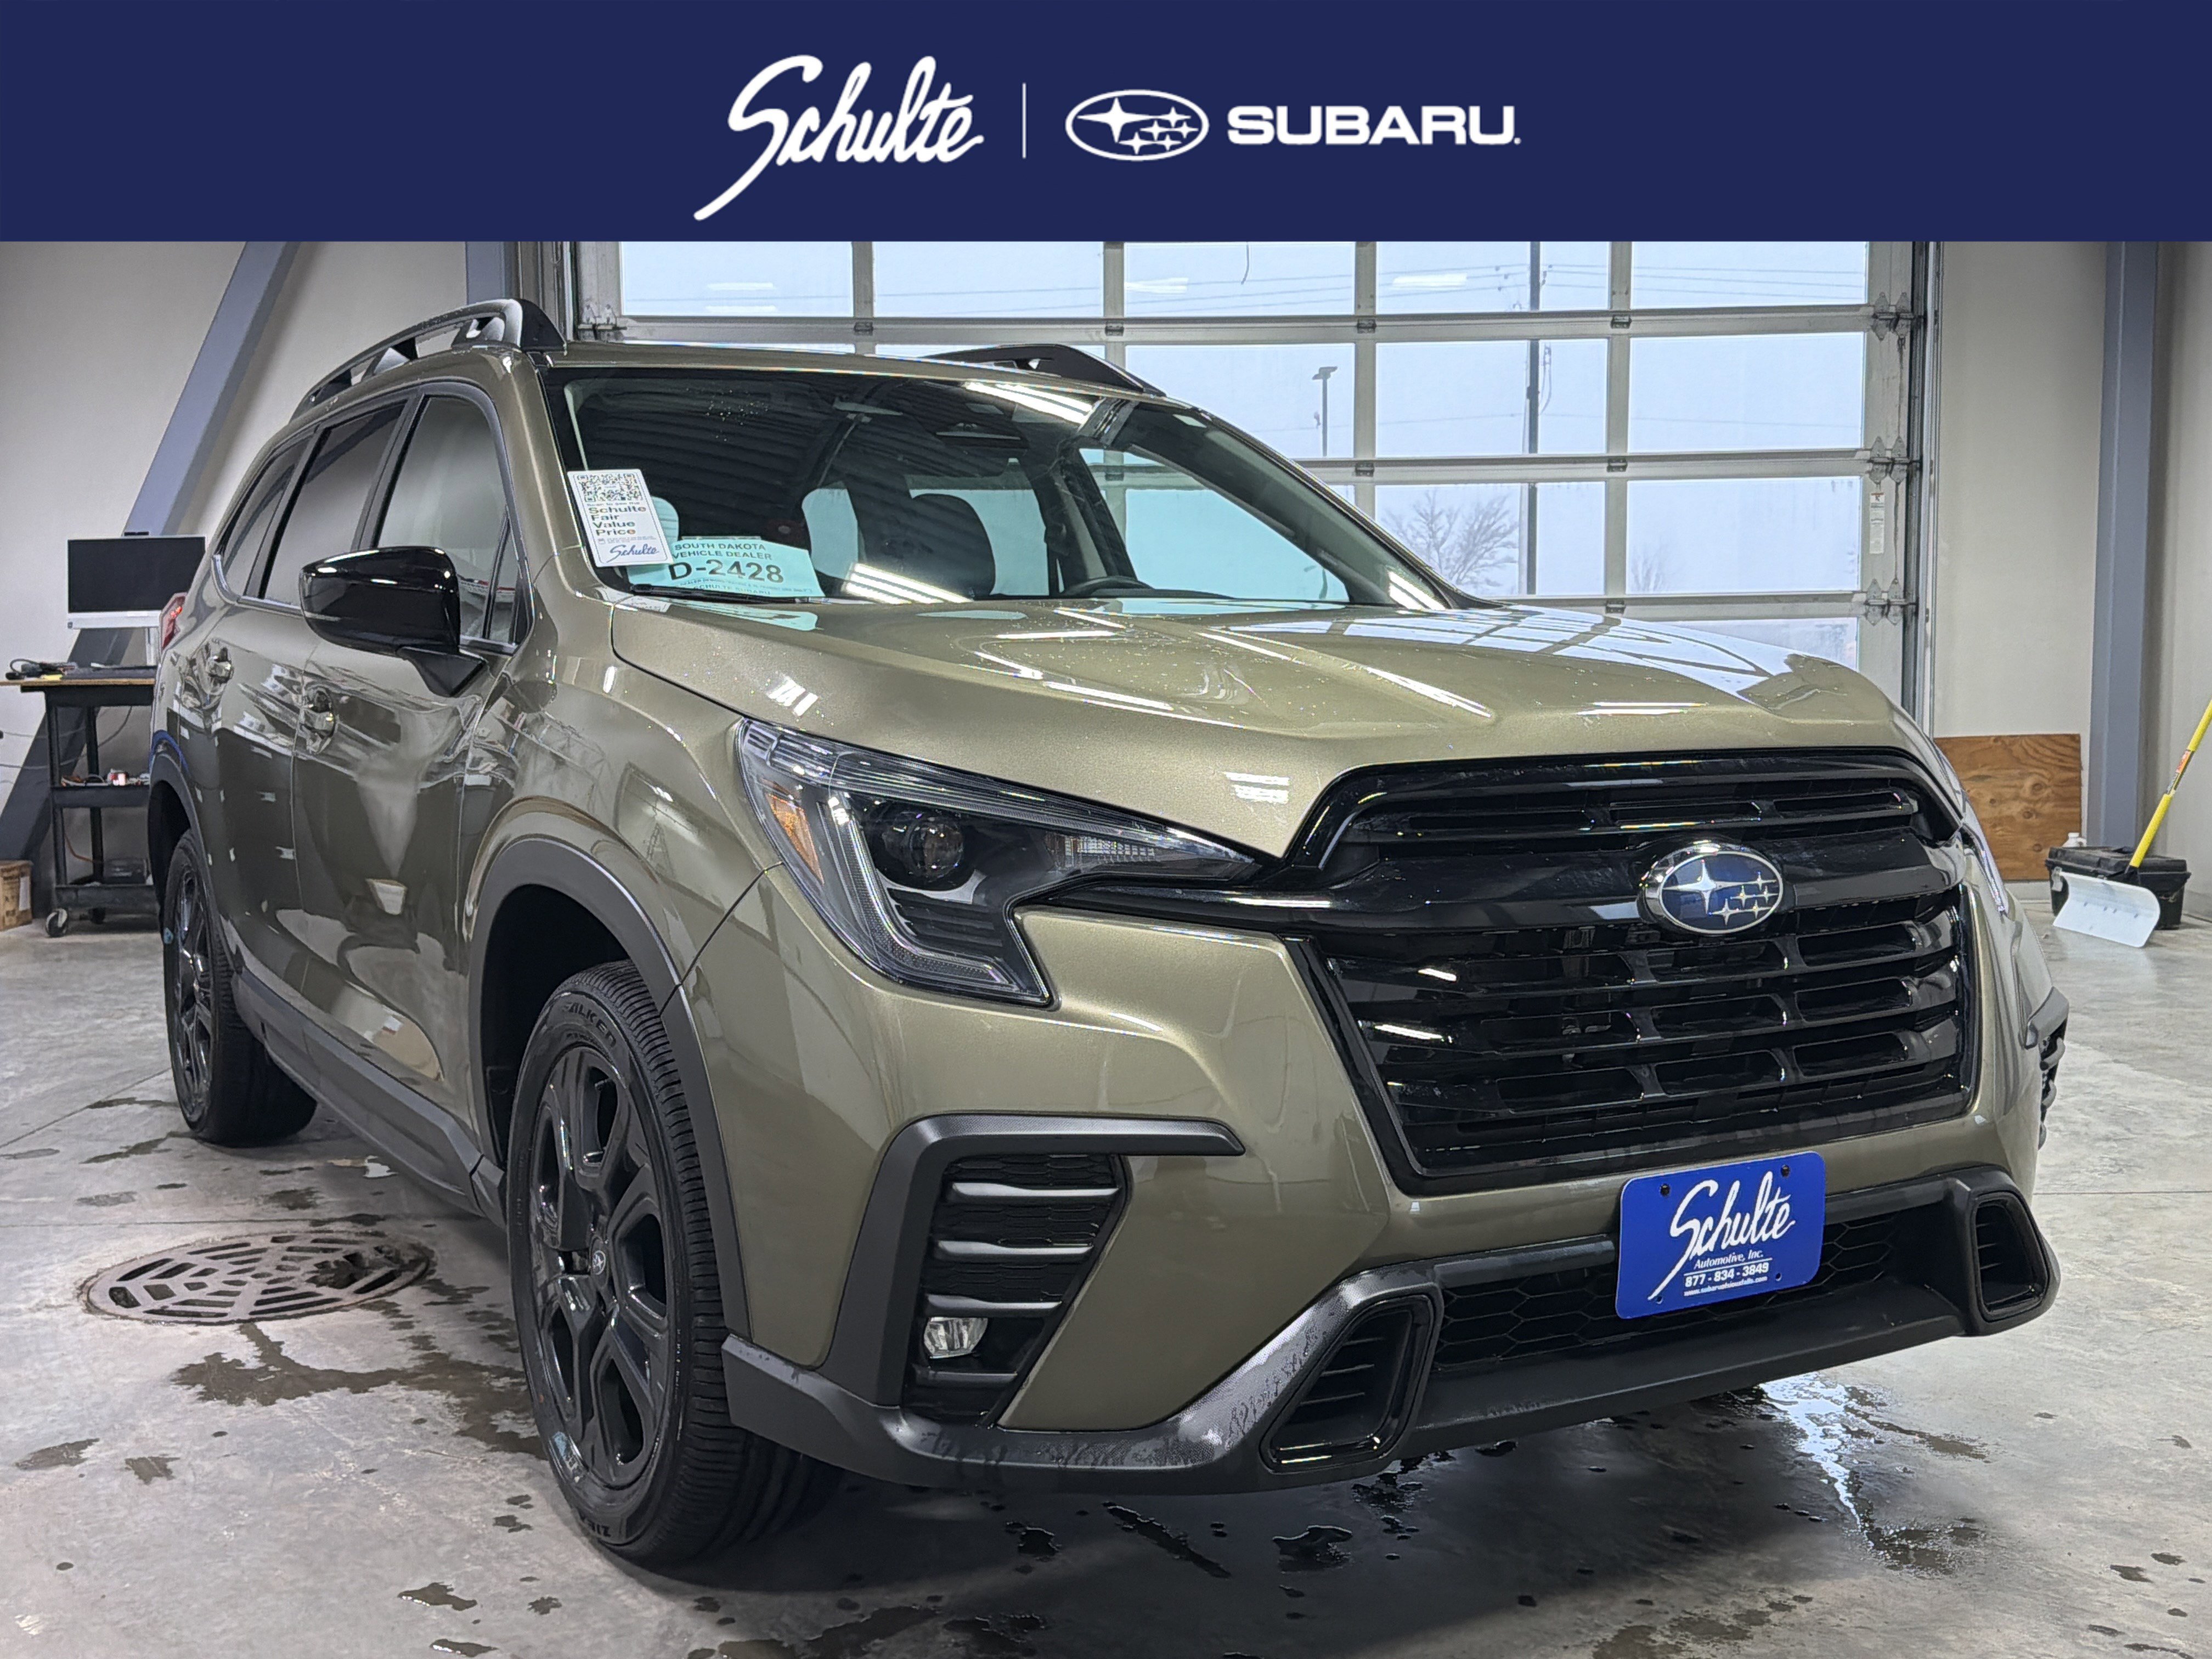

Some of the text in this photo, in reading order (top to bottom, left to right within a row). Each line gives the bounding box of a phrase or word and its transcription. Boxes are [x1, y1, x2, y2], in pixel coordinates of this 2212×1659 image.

[588, 505, 646, 514] Schulte
[606, 543, 660, 563] Schulte
[672, 551, 772, 561] VEHICLE DEALER
[668, 558, 785, 584] D-2428
[1647, 1170, 1796, 1301] Schulte
[1748, 1249, 1764, 1260] Inc.
